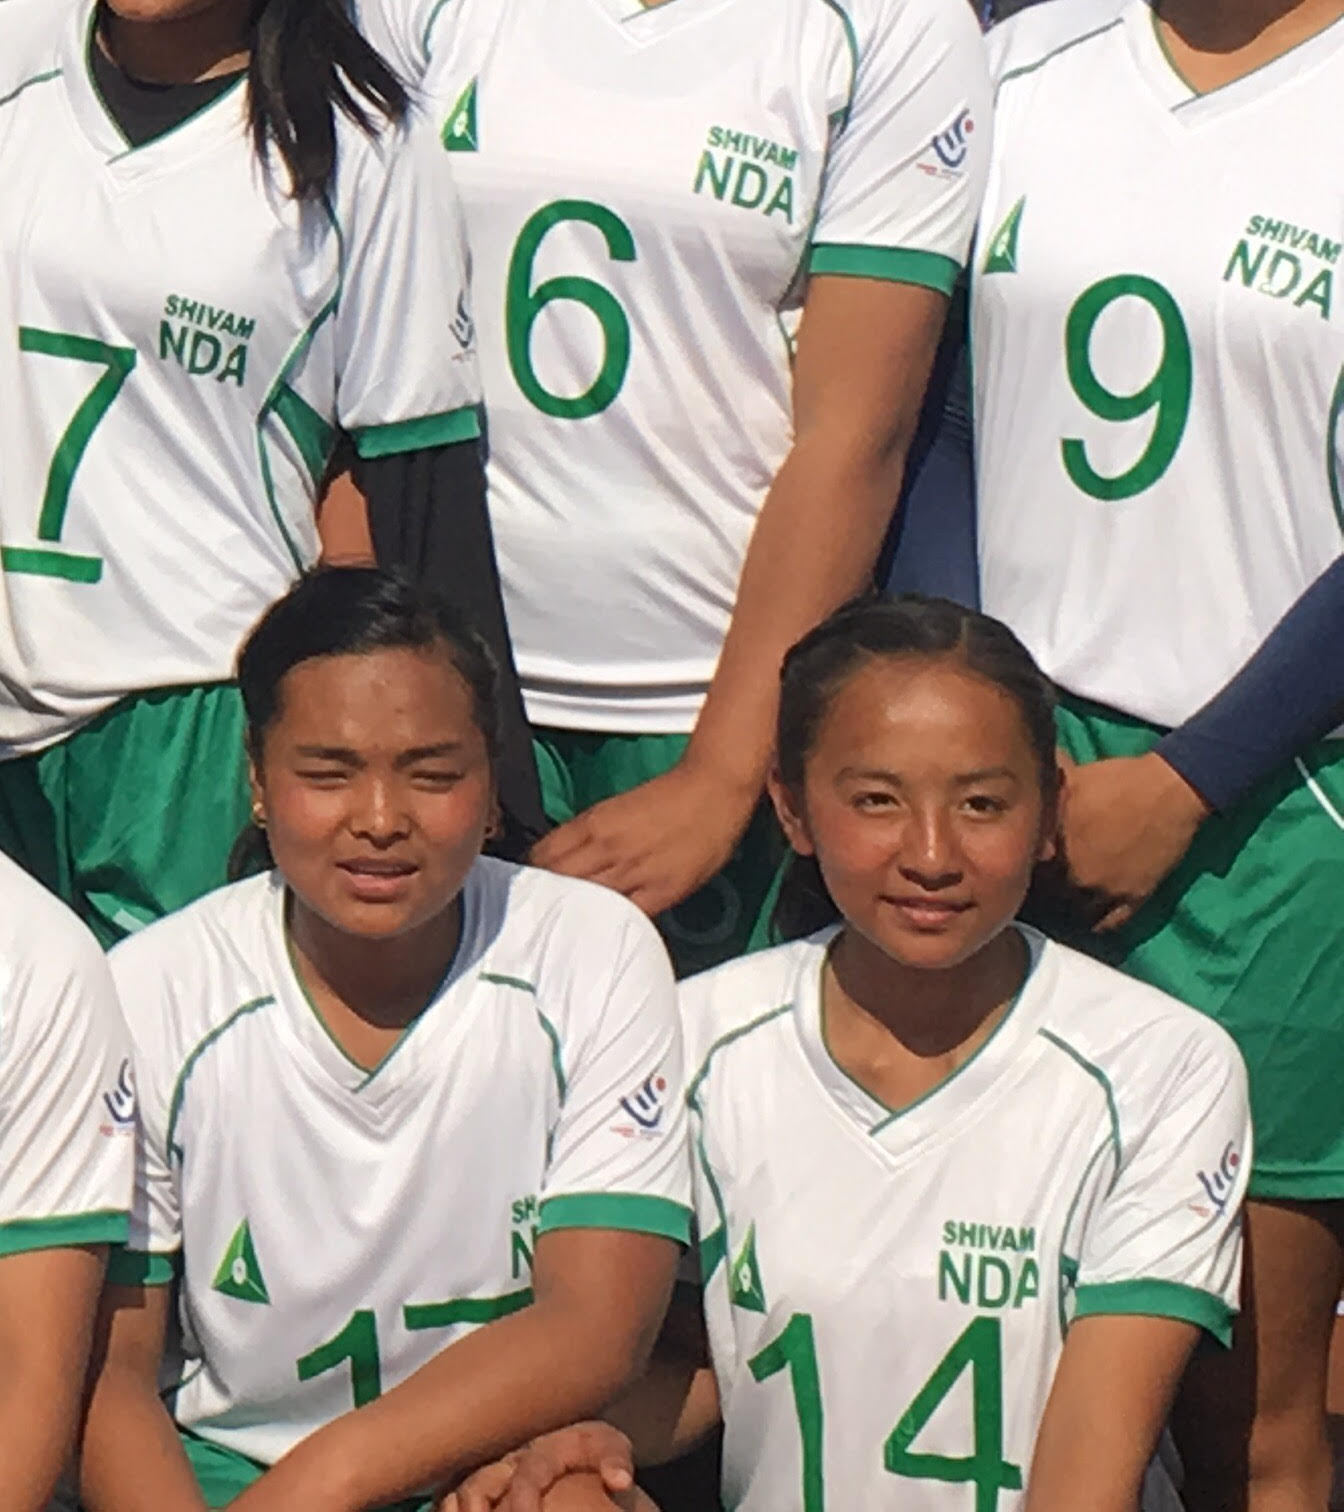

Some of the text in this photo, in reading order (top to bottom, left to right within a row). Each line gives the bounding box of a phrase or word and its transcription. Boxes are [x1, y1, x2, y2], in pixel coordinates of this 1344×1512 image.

[706, 126, 799, 171] SHIVAM
[693, 149, 793, 225] NDA
[1245, 214, 1342, 264] SHIVAM
[506, 198, 638, 421] 6
[1222, 239, 1332, 321] NDA
[164, 294, 256, 340] SHIVAM
[159, 319, 248, 388] NDA
[1061, 273, 1194, 502] 9
[18, 326, 138, 544] 7
[942, 1219, 1036, 1252] SHIVAM
[938, 1249, 1039, 1310] NDA
[747, 1314, 1023, 1512] 14
